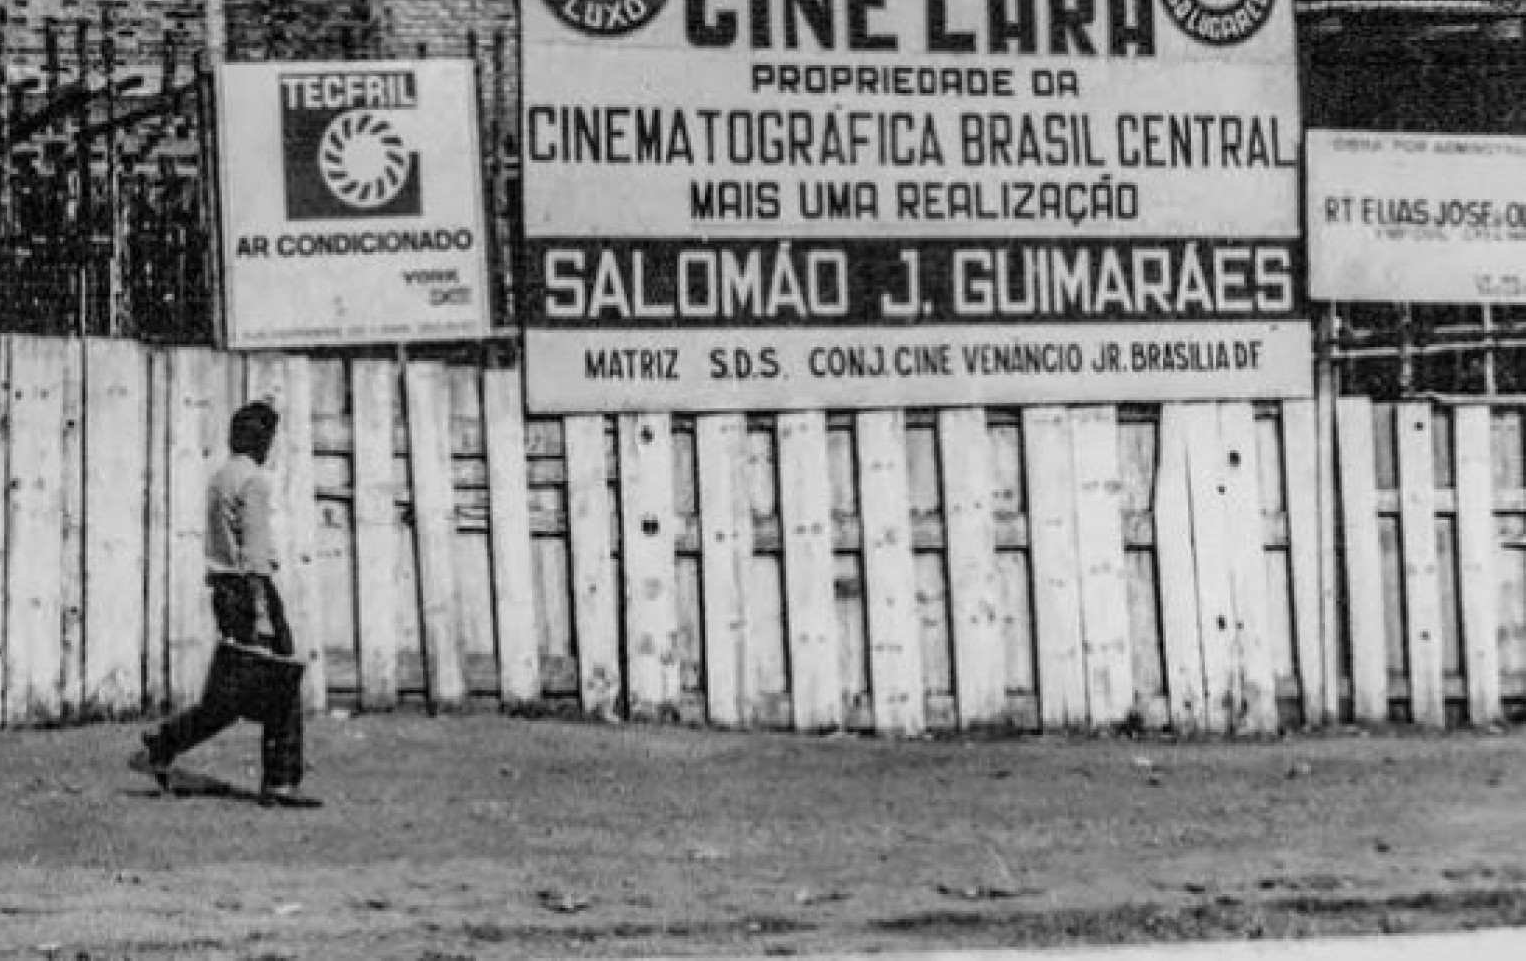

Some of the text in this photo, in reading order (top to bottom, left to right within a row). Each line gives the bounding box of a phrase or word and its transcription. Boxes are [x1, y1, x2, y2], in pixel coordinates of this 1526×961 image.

[751, 64, 1081, 97] PROPRIEDADE DA
[959, 110, 1106, 167] BRASIL
[1116, 112, 1299, 168] CENTRAL
[690, 174, 1139, 226] MAIS UMA REALIZAÇÃO
[1361, 198, 1429, 226] ELIAS
[237, 229, 473, 258] AR CONDICIONADO
[880, 247, 933, 318] J.
[583, 348, 680, 380] MATRIZ
[893, 343, 954, 377] CINE
